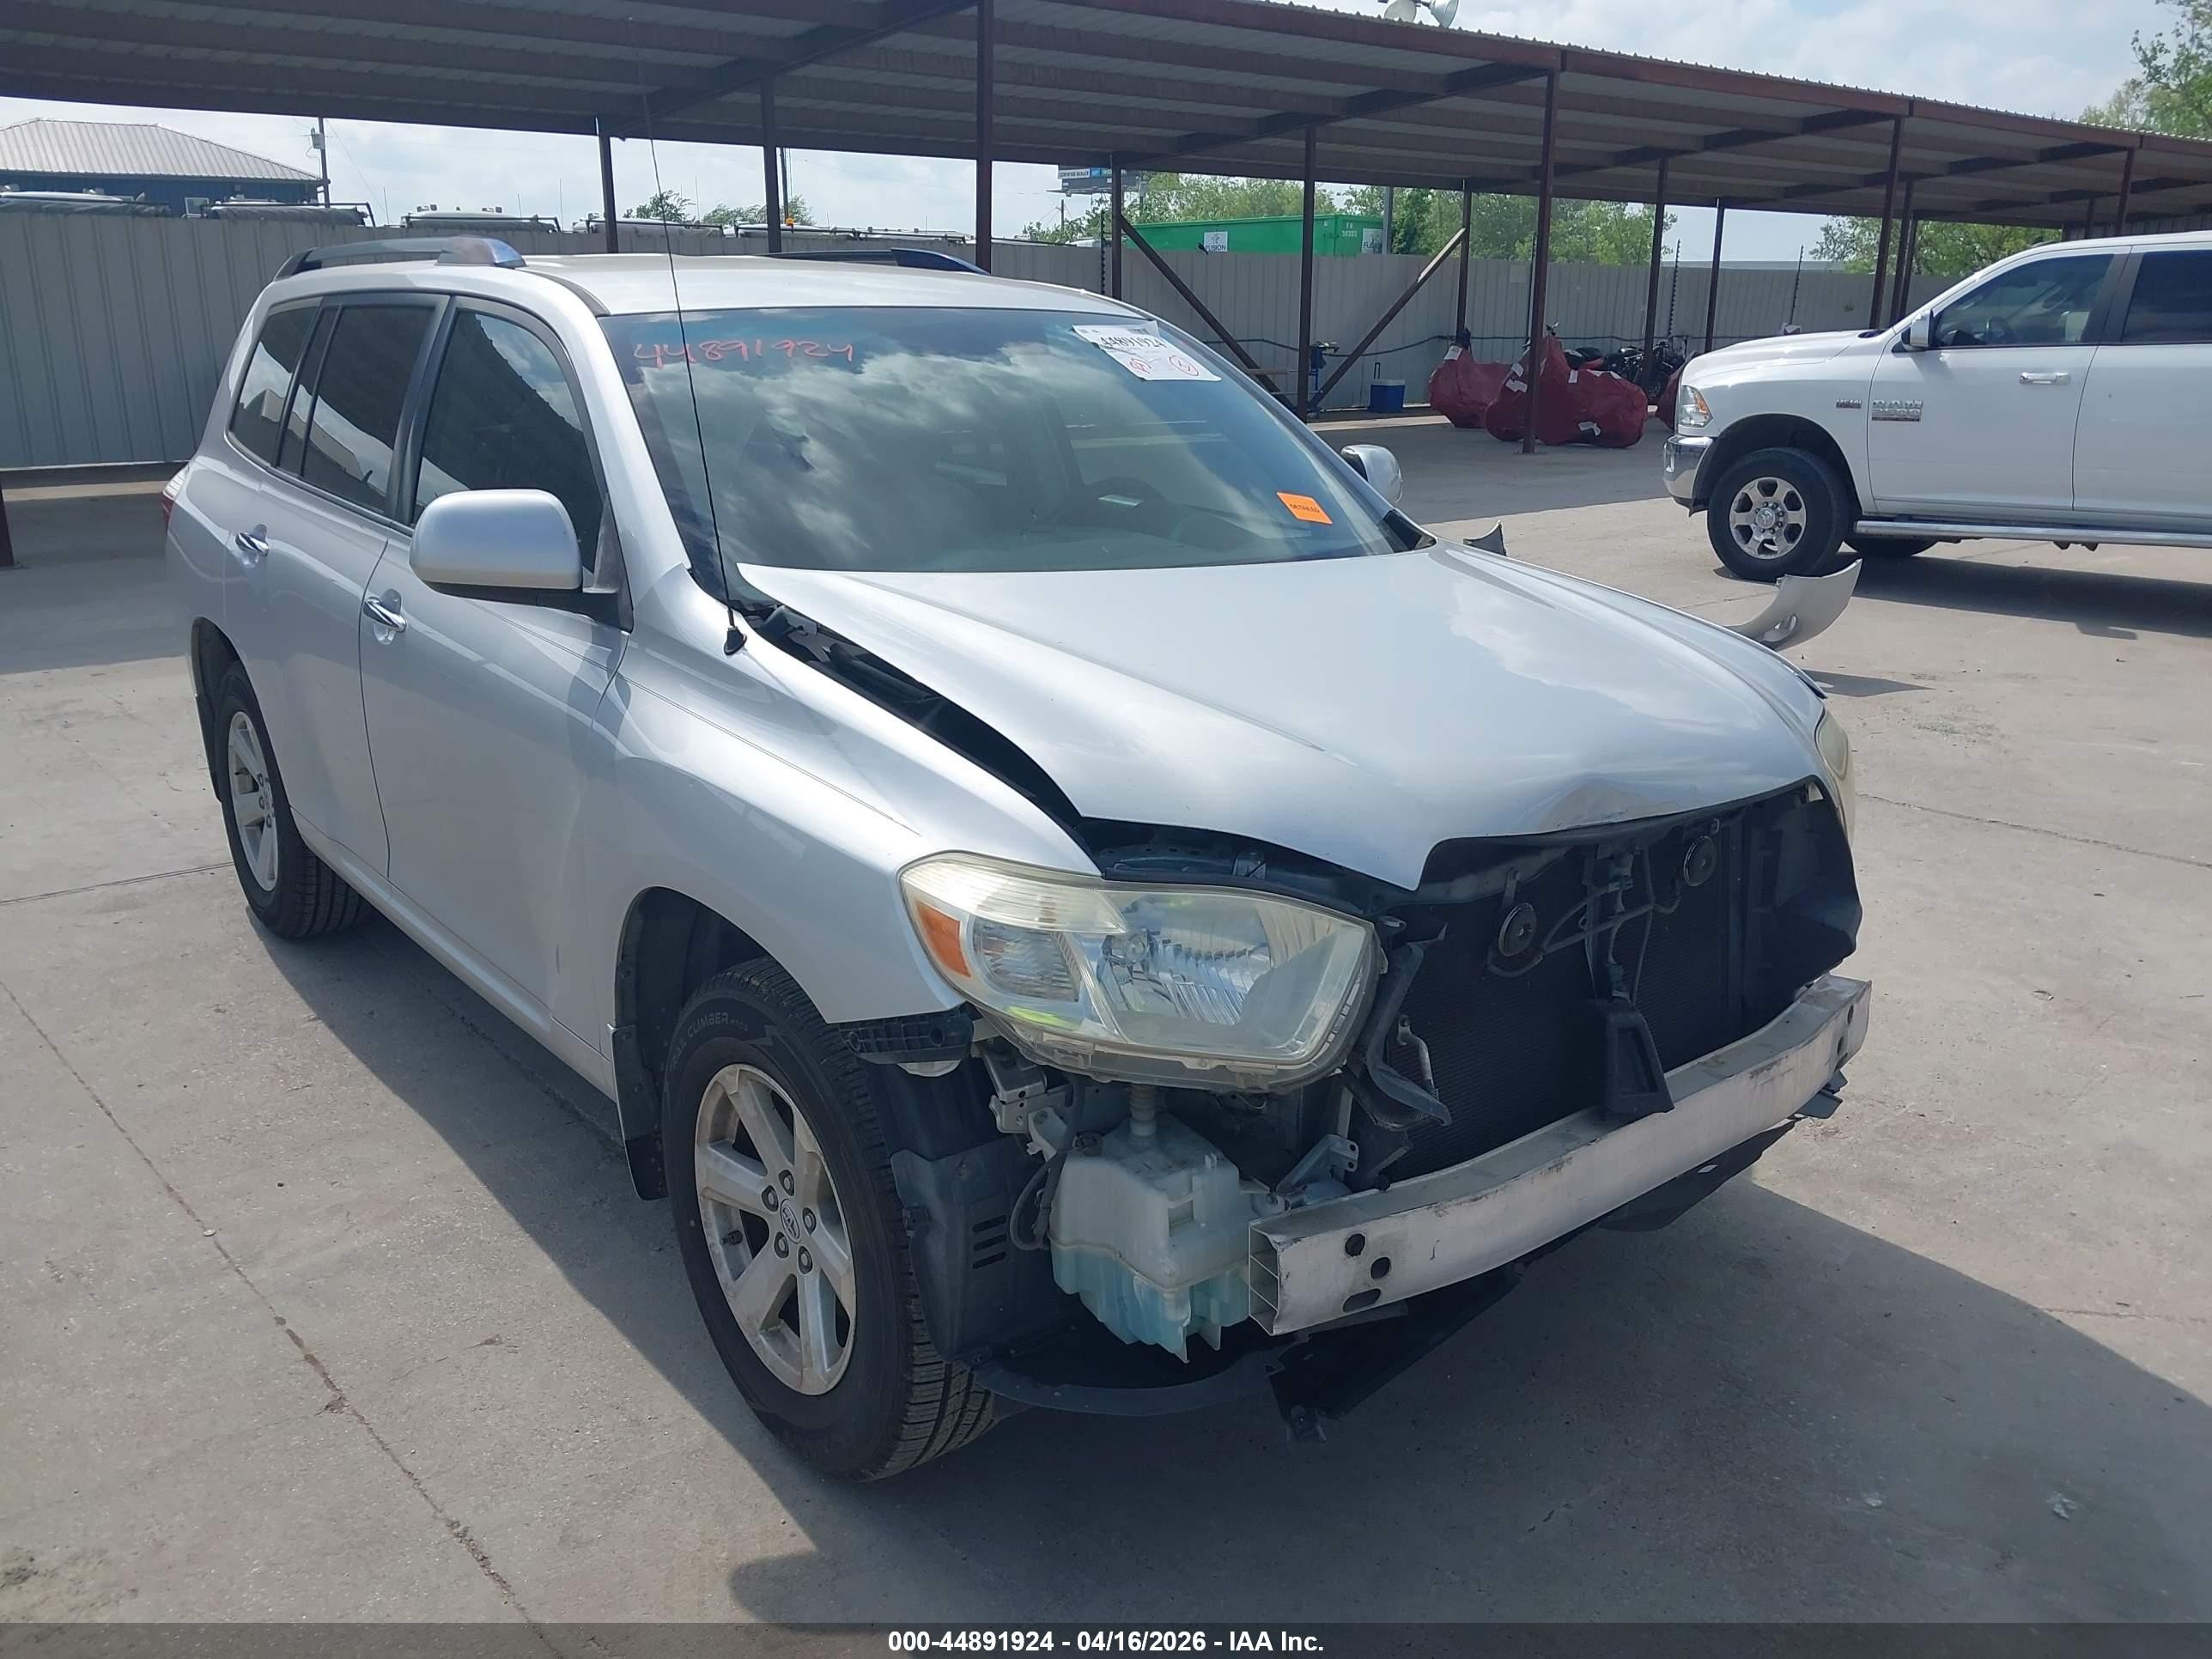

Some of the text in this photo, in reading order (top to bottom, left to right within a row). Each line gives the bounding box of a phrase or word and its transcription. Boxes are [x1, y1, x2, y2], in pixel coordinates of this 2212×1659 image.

[633, 339, 854, 370] 44891924
[1100, 337, 1167, 349] 44891924
[687, 1012, 730, 1038] CLIMBER
